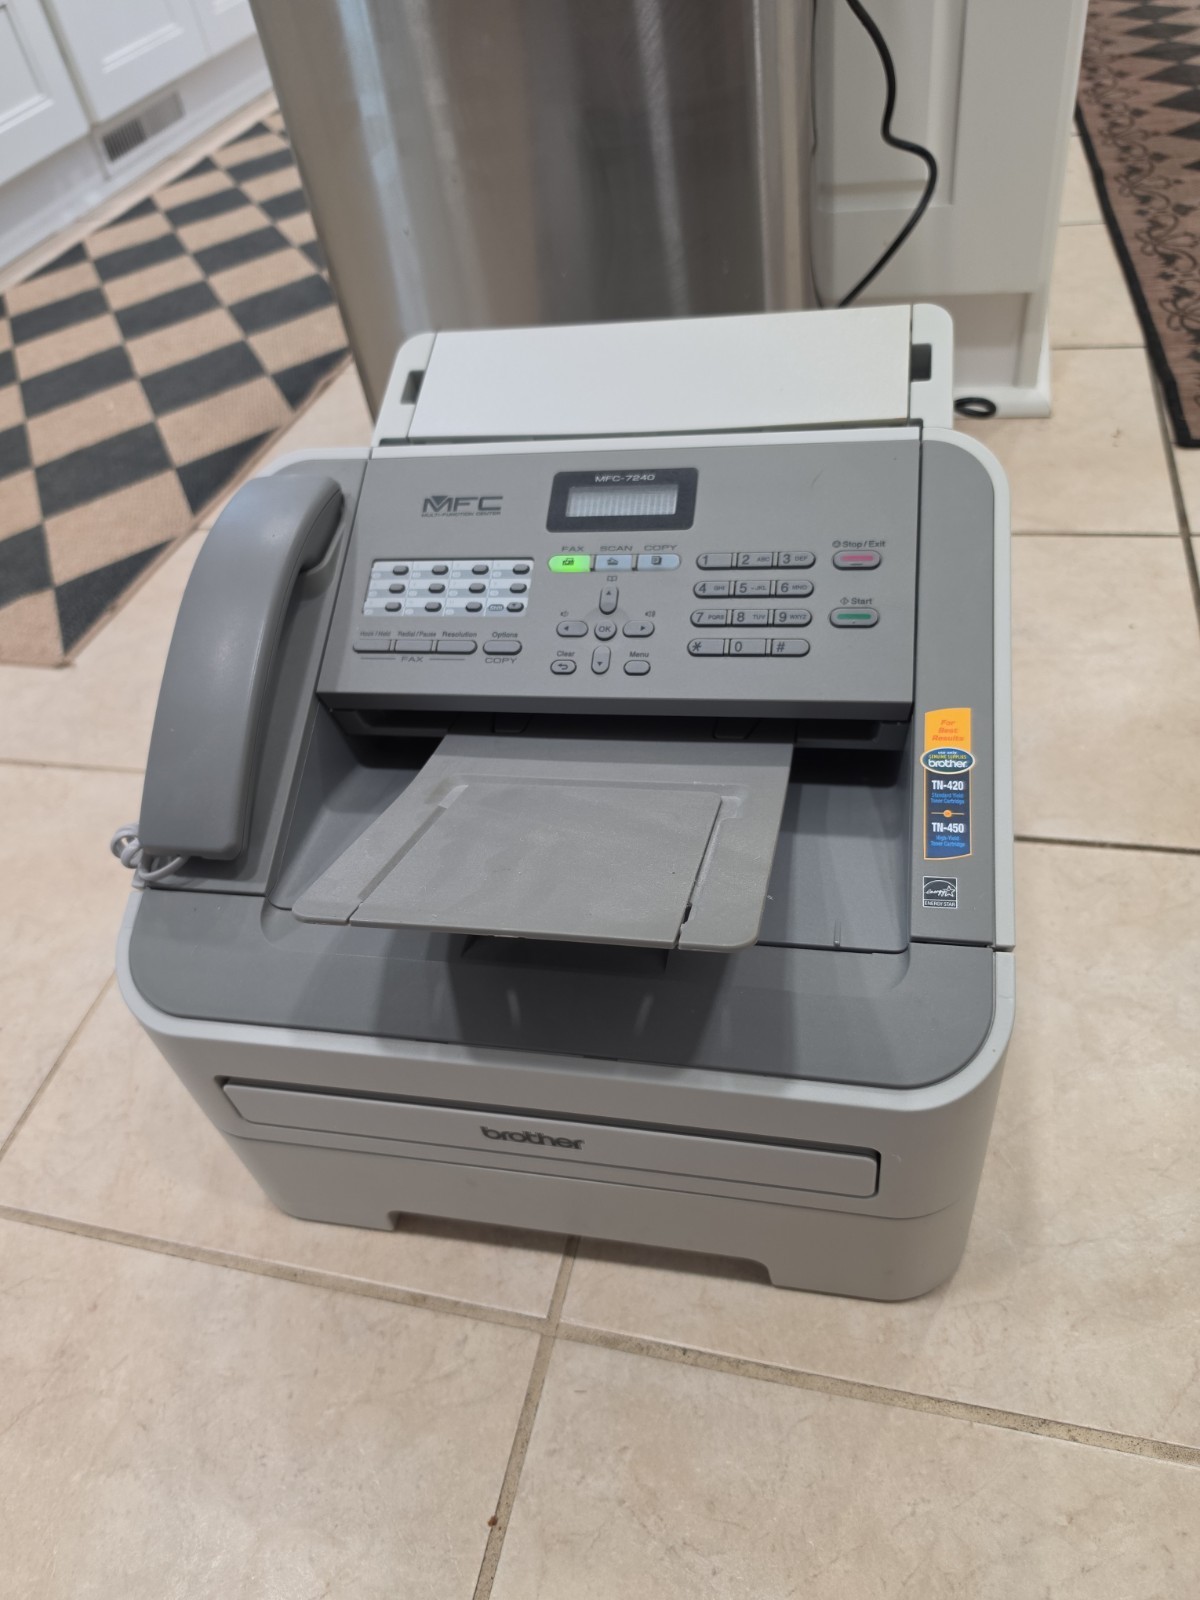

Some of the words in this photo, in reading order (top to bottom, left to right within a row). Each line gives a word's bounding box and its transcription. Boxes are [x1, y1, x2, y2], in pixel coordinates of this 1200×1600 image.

[594, 474, 656, 483] MFC-7240
[422, 495, 504, 512] MFC
[643, 544, 678, 552] COPY
[702, 554, 709, 566] 1
[741, 554, 750, 565] 2
[782, 553, 791, 565] 3
[698, 583, 707, 594] 4
[739, 582, 748, 593] 5
[780, 582, 789, 593] 6
[850, 597, 873, 605] Start
[695, 612, 704, 623] 7
[736, 611, 746, 622] 8
[778, 611, 788, 623] 9
[598, 625, 612, 633] OK
[442, 631, 478, 639] Resolution
[491, 631, 519, 640] Options
[734, 641, 743, 653] 0
[776, 642, 786, 653] #
[556, 650, 575, 658] Clear
[629, 651, 650, 659] Menu
[484, 657, 518, 665] COPY
[928, 759, 967, 768] brother
[931, 780, 964, 791] TN-420
[931, 822, 965, 834] TN-450
[480, 1125, 585, 1150] brother
